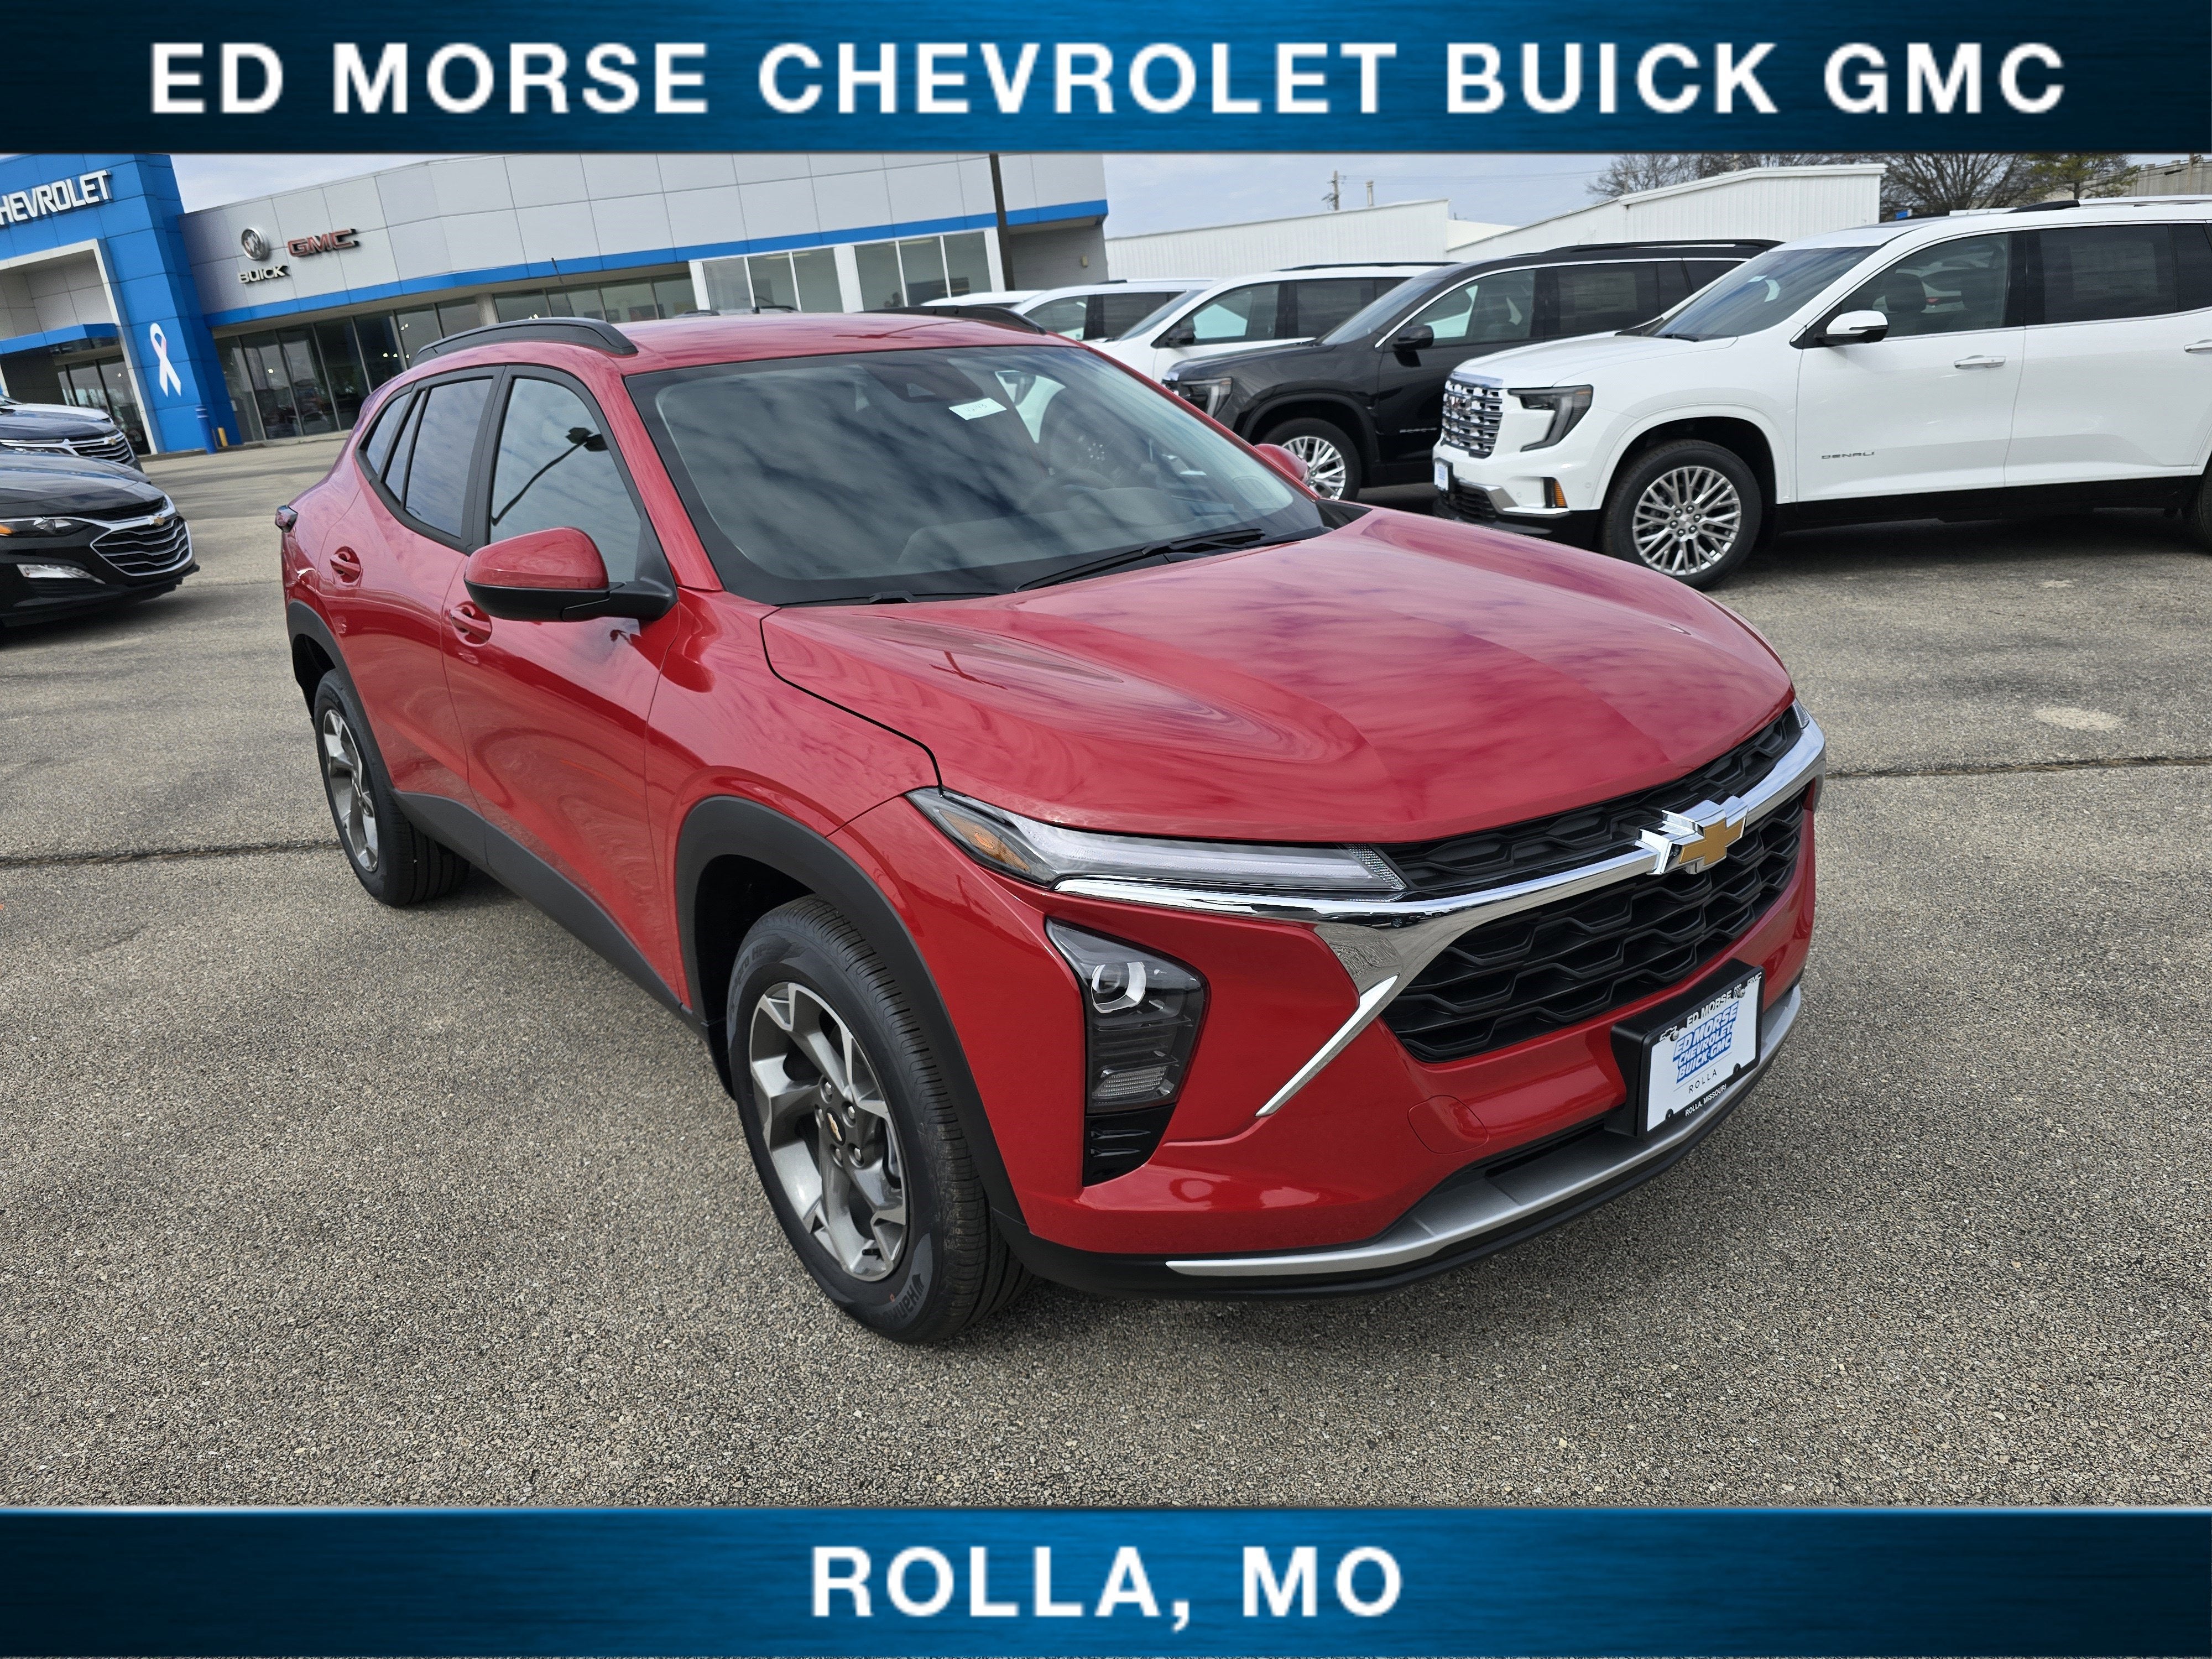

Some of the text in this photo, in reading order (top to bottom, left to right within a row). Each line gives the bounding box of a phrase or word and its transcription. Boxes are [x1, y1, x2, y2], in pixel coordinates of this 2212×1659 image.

[0, 170, 109, 226] HEVROLET
[287, 229, 355, 257] GMC
[238, 265, 286, 284] BUICK
[1821, 451, 1875, 460] DENALI
[1687, 989, 1732, 1026] ED MORSE
[1673, 1003, 1739, 1058] ED MORSE
[1677, 1021, 1733, 1067] CHEVROLET
[1677, 1034, 1733, 1081] BUICK GMC
[1689, 1069, 1717, 1094] ROLLA
[1685, 1083, 1727, 1117] ROLLA, MISSOURI
